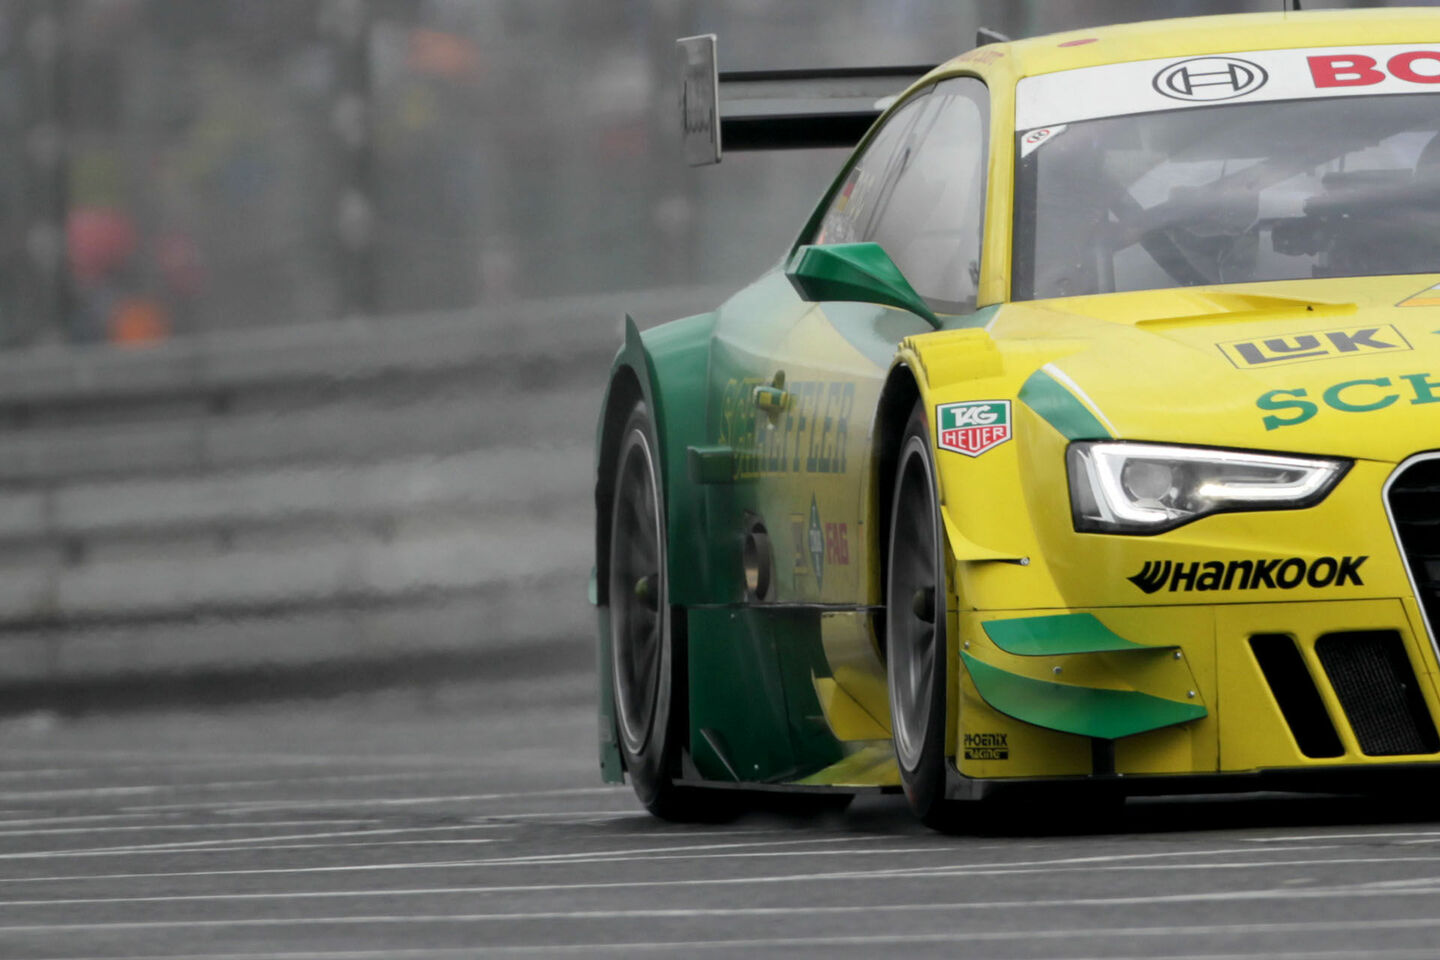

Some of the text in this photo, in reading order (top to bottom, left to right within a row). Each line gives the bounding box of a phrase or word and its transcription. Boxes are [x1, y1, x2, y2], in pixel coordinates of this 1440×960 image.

[950, 404, 998, 427] TAG
[945, 427, 1005, 451] HEUER
[824, 521, 850, 566] FAG
